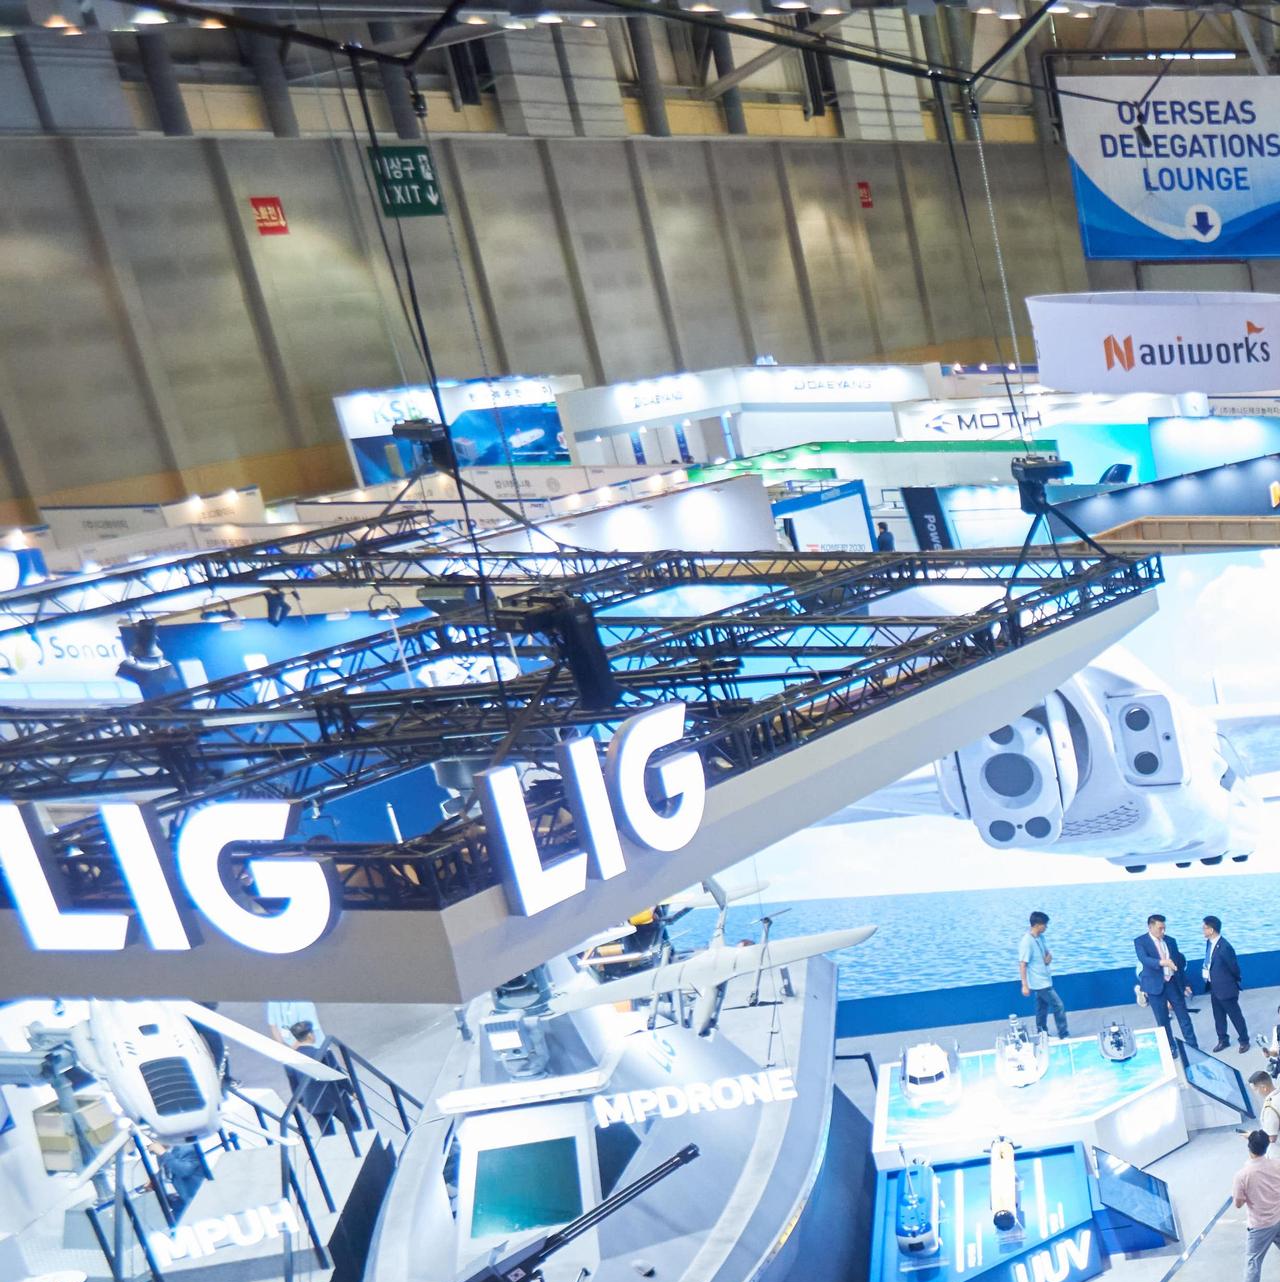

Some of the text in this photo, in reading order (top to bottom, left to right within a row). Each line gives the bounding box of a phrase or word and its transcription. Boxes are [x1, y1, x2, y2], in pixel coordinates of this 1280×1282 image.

[1118, 100, 1257, 125] OVERSEAS
[1142, 167, 1251, 191] LOUNGE
[1103, 330, 1271, 373] Naviworks
[484, 702, 706, 918] LIG
[0, 803, 332, 954] LIG
[592, 1067, 799, 1129] MPDRONE
[148, 1197, 300, 1268] MPUH
